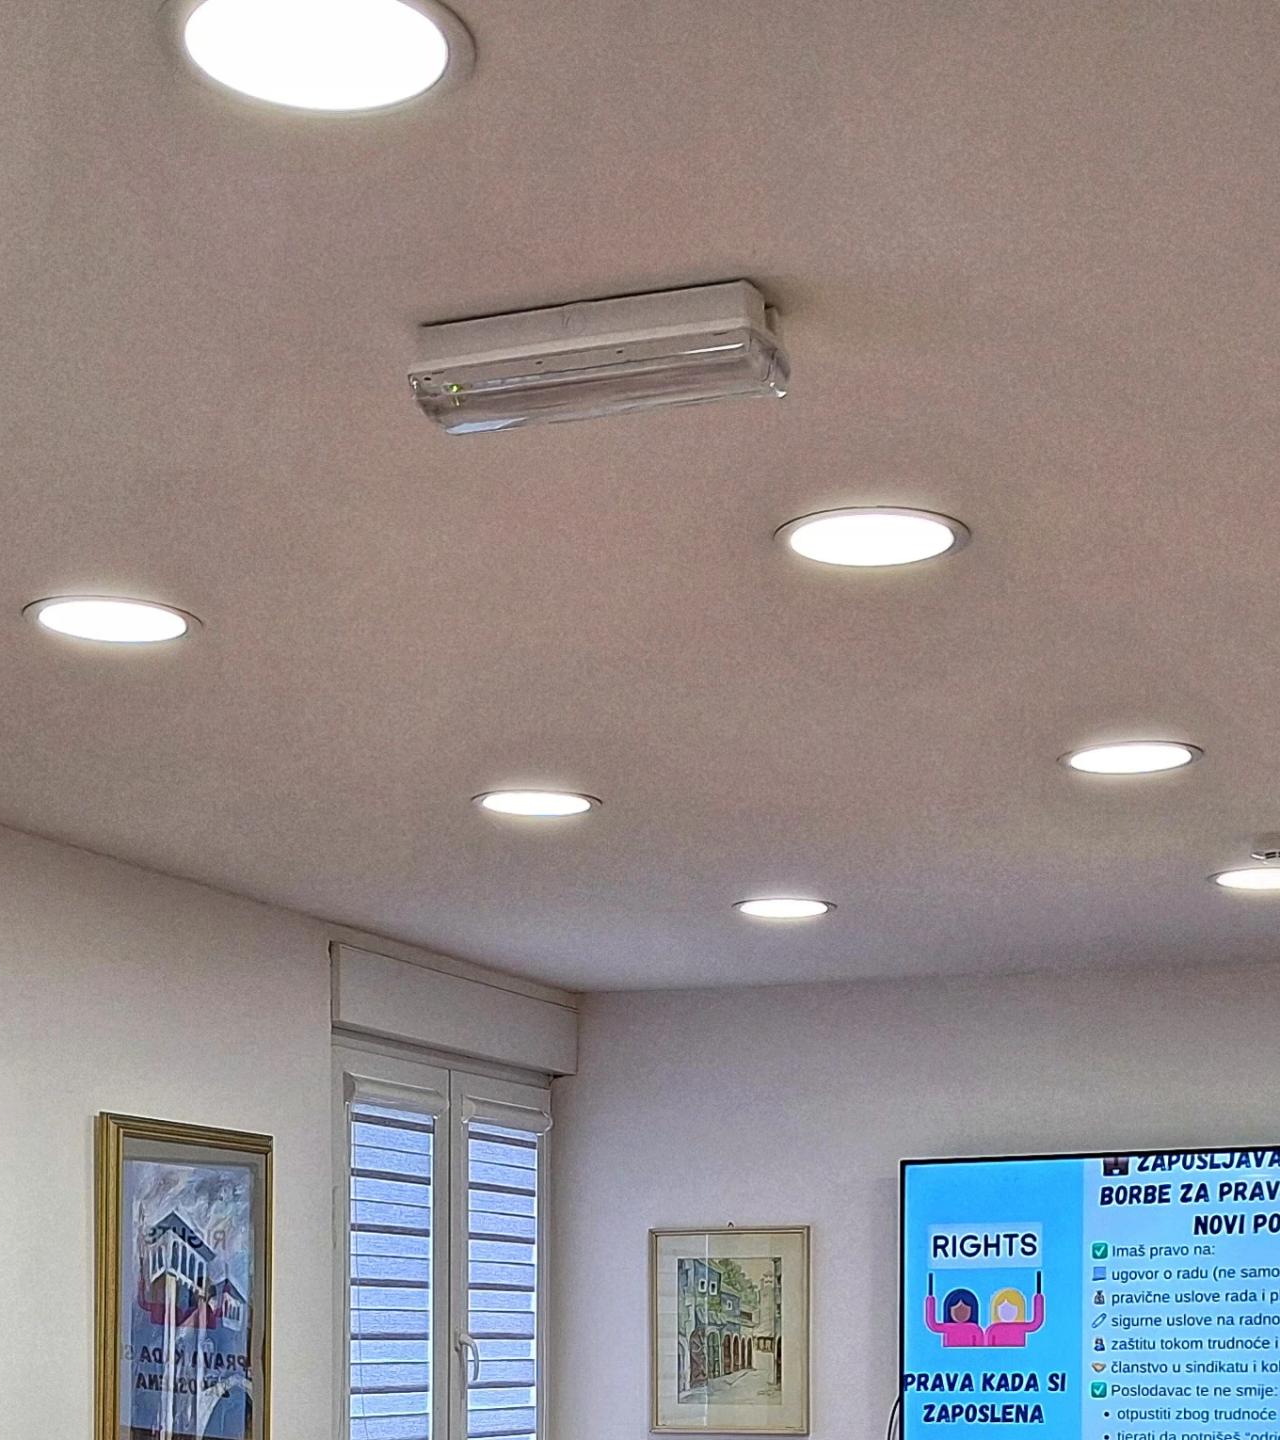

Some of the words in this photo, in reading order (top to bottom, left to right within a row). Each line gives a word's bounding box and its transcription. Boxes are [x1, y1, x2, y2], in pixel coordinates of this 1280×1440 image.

[1099, 1184, 1171, 1206] BORBE
[1179, 1183, 1210, 1203] ZA
[1194, 1214, 1245, 1236] NOVI
[932, 1232, 1038, 1259] RIGHTS
[1112, 1244, 1146, 1257] Imaš
[1149, 1245, 1189, 1259] pravo
[1193, 1244, 1216, 1256] na:
[1112, 1269, 1160, 1283] ugovor
[1163, 1270, 1172, 1280] o
[1176, 1266, 1208, 1279] radu
[1212, 1265, 1236, 1282] (ne
[1240, 1267, 1280, 1279] samo
[1111, 1290, 1170, 1306] pravične
[1174, 1290, 1220, 1303] uslove
[1225, 1289, 1257, 1302] rada
[1111, 1314, 1162, 1329] sigurne
[1166, 1313, 1212, 1326] uslove
[1216, 1315, 1235, 1326] na
[1111, 1337, 1156, 1350] zaštitu
[1160, 1337, 1203, 1350] tokom
[1207, 1336, 1270, 1349] trudnoće
[1110, 1361, 1168, 1374] članstvo
[1172, 1363, 1181, 1373] u
[1185, 1360, 1249, 1373] sindikatu
[903, 1372, 974, 1392] PRAVA
[981, 1372, 1040, 1392] KADA
[1047, 1372, 1067, 1392] SI
[1111, 1384, 1193, 1397] Poslodavac
[1195, 1385, 1209, 1397] te
[1213, 1387, 1232, 1397] ne
[1235, 1384, 1279, 1400] smije:
[922, 1403, 1045, 1424] ZAPOSLENA
[1117, 1408, 1171, 1422] otpustiti
[1175, 1408, 1210, 1423] zbog
[1214, 1407, 1277, 1421] trudnoće
